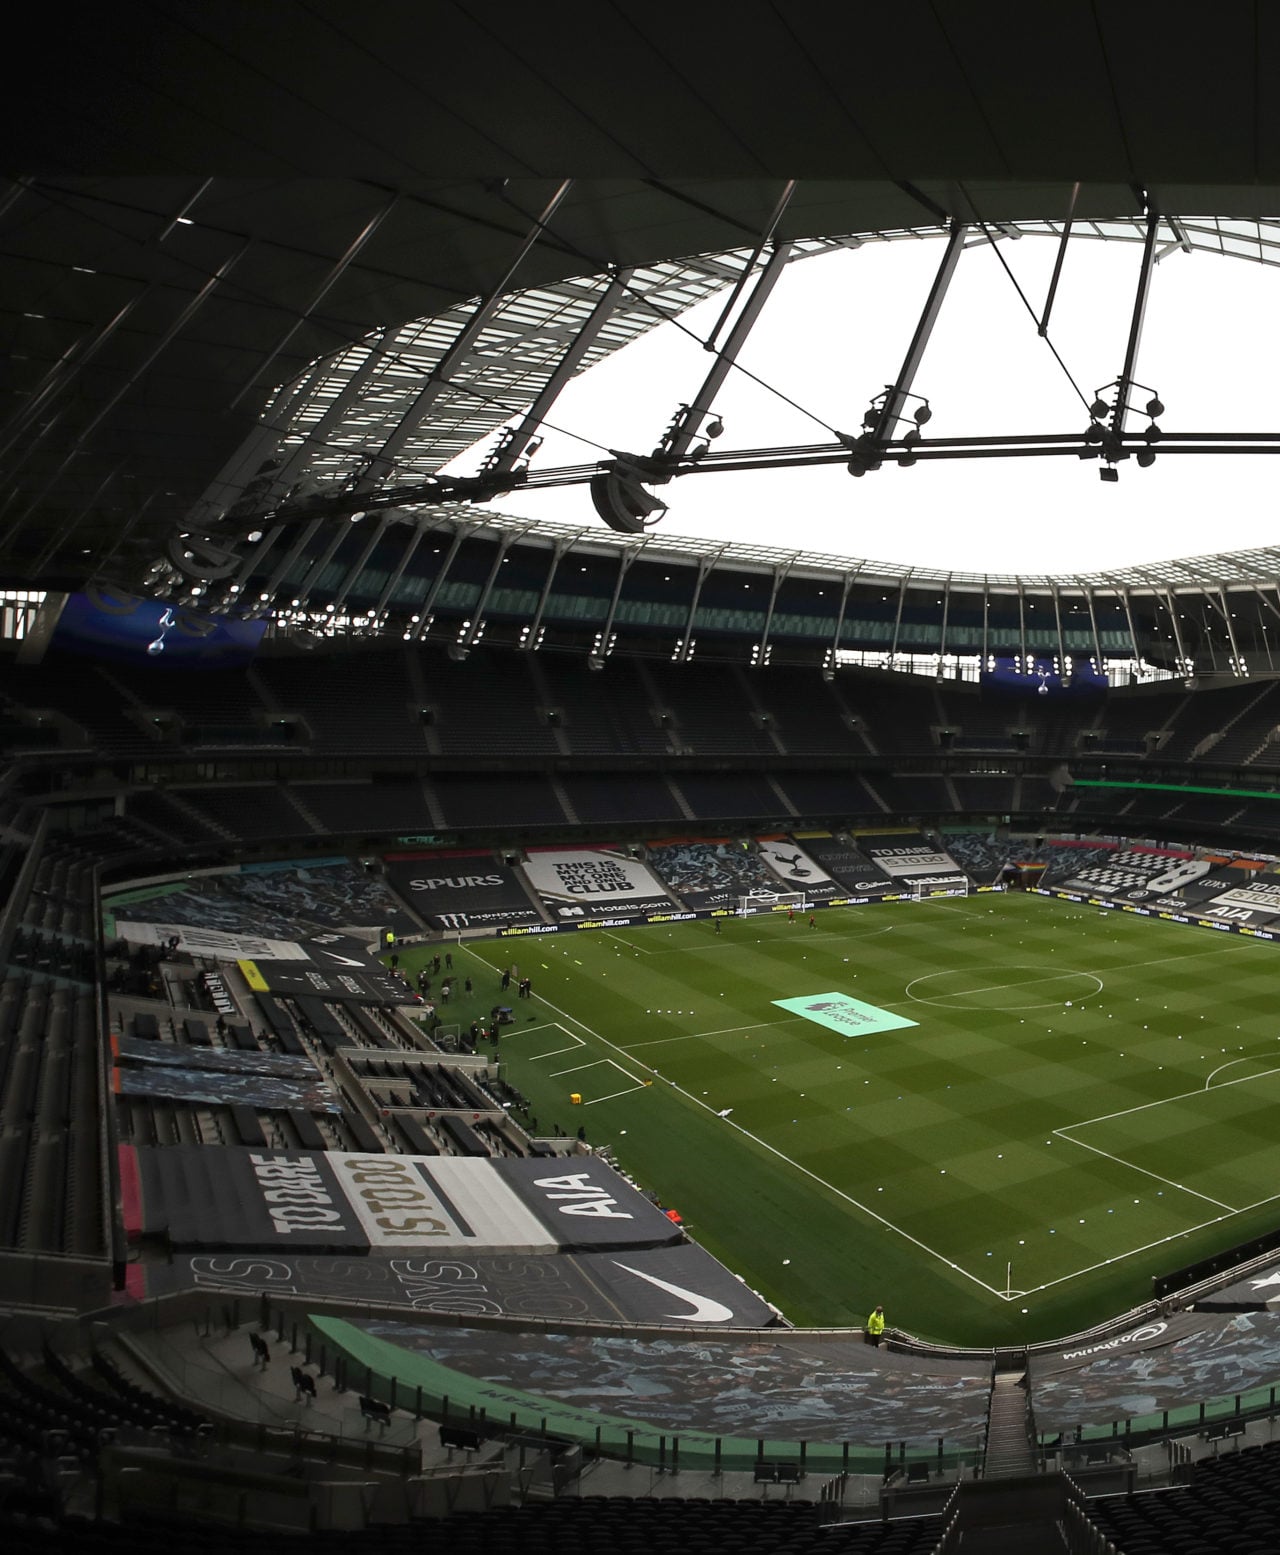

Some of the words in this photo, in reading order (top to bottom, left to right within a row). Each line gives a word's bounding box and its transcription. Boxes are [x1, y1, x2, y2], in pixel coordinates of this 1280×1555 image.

[871, 849, 894, 857] TO
[894, 846, 935, 856] DARE
[552, 862, 596, 870] THIS
[598, 860, 617, 869] IS
[409, 874, 504, 891] SPURS
[560, 874, 588, 882] MY
[567, 882, 635, 894] CLUB
[1246, 882, 1269, 892] TO
[591, 901, 672, 913] Hotels.com
[1205, 906, 1254, 920] AIA
[647, 912, 697, 923] williamhill.com
[577, 919, 630, 929] williamhill.com
[501, 925, 558, 936] williamhill.com
[344, 1159, 417, 1187] DO
[249, 1153, 334, 1206] DARE
[361, 1188, 434, 1212] TO
[533, 1172, 635, 1220] AIA
[269, 1205, 347, 1234] TO
[376, 1216, 450, 1238] IS
